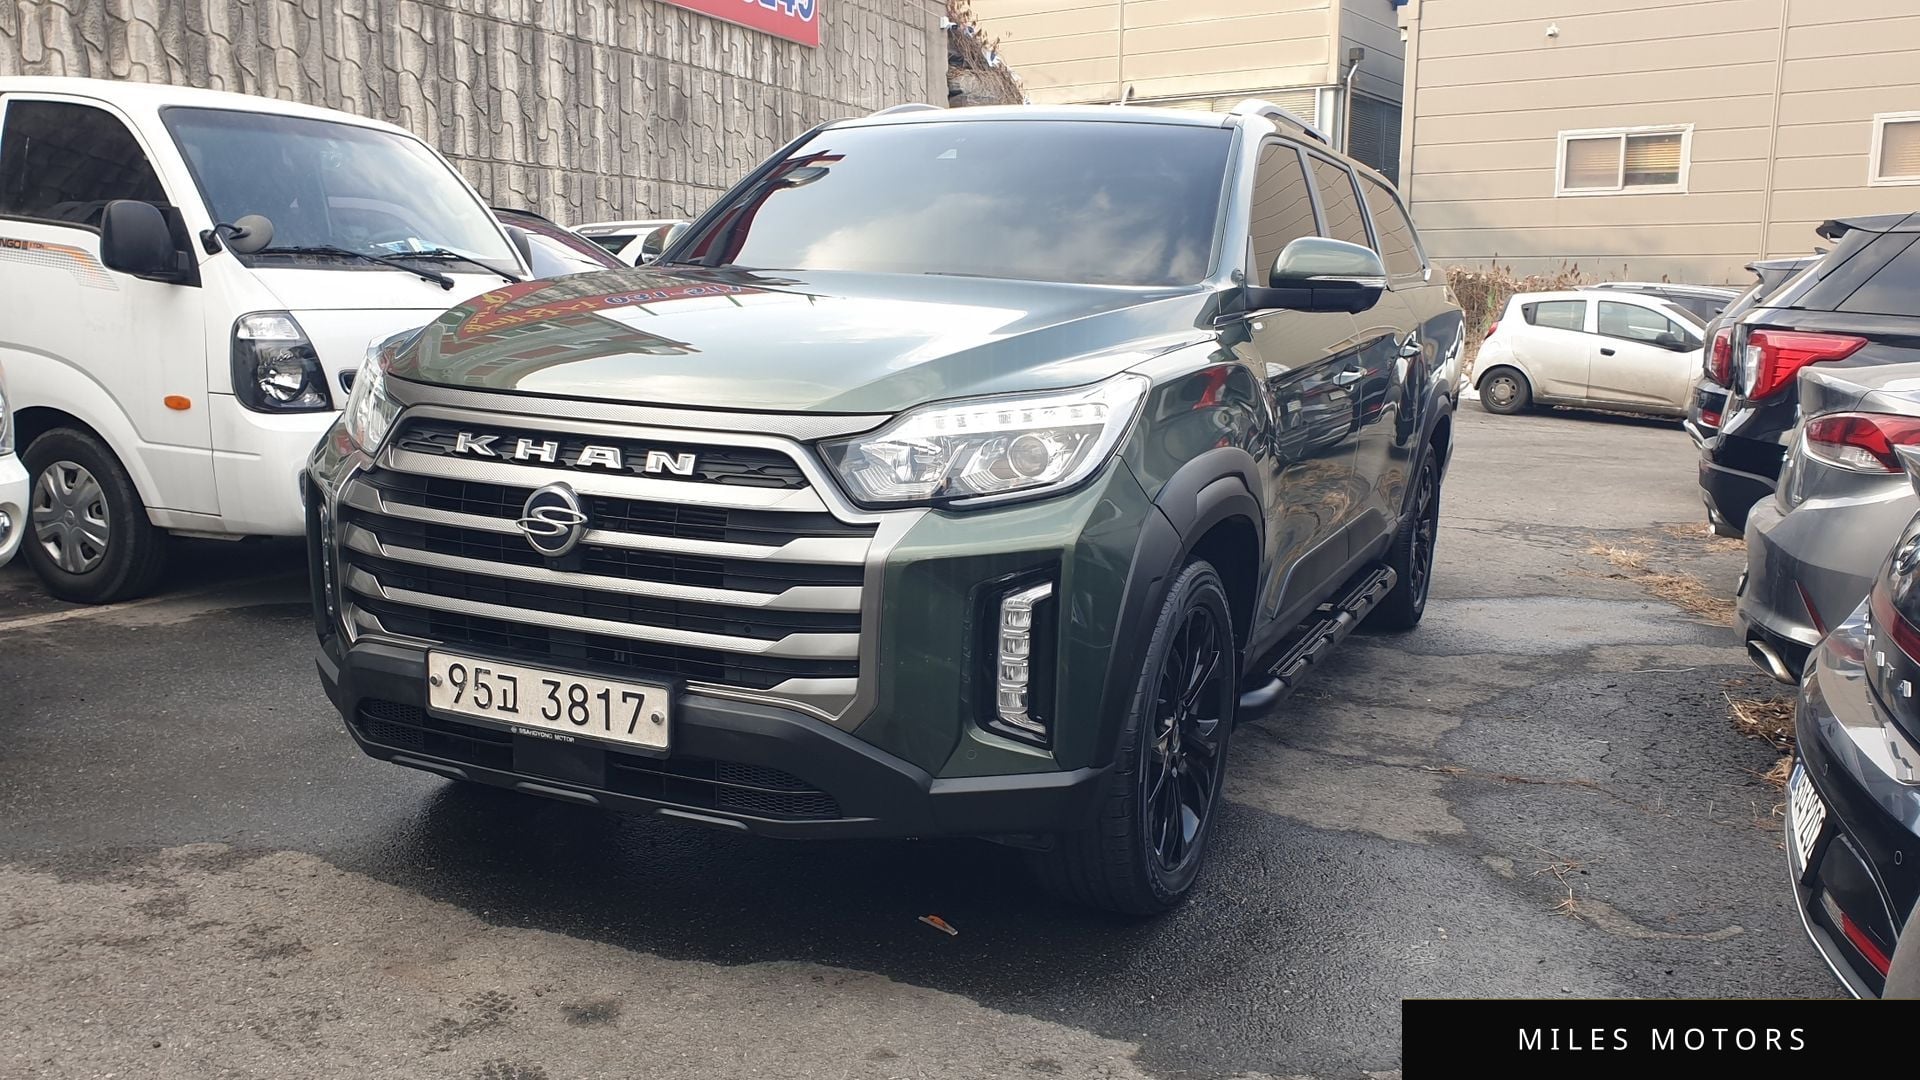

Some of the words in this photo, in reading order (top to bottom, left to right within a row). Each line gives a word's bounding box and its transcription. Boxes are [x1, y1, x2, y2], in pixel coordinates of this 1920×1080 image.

[455, 432, 697, 476] KHAN
[448, 662, 519, 713] 95고
[541, 678, 646, 734] 3817
